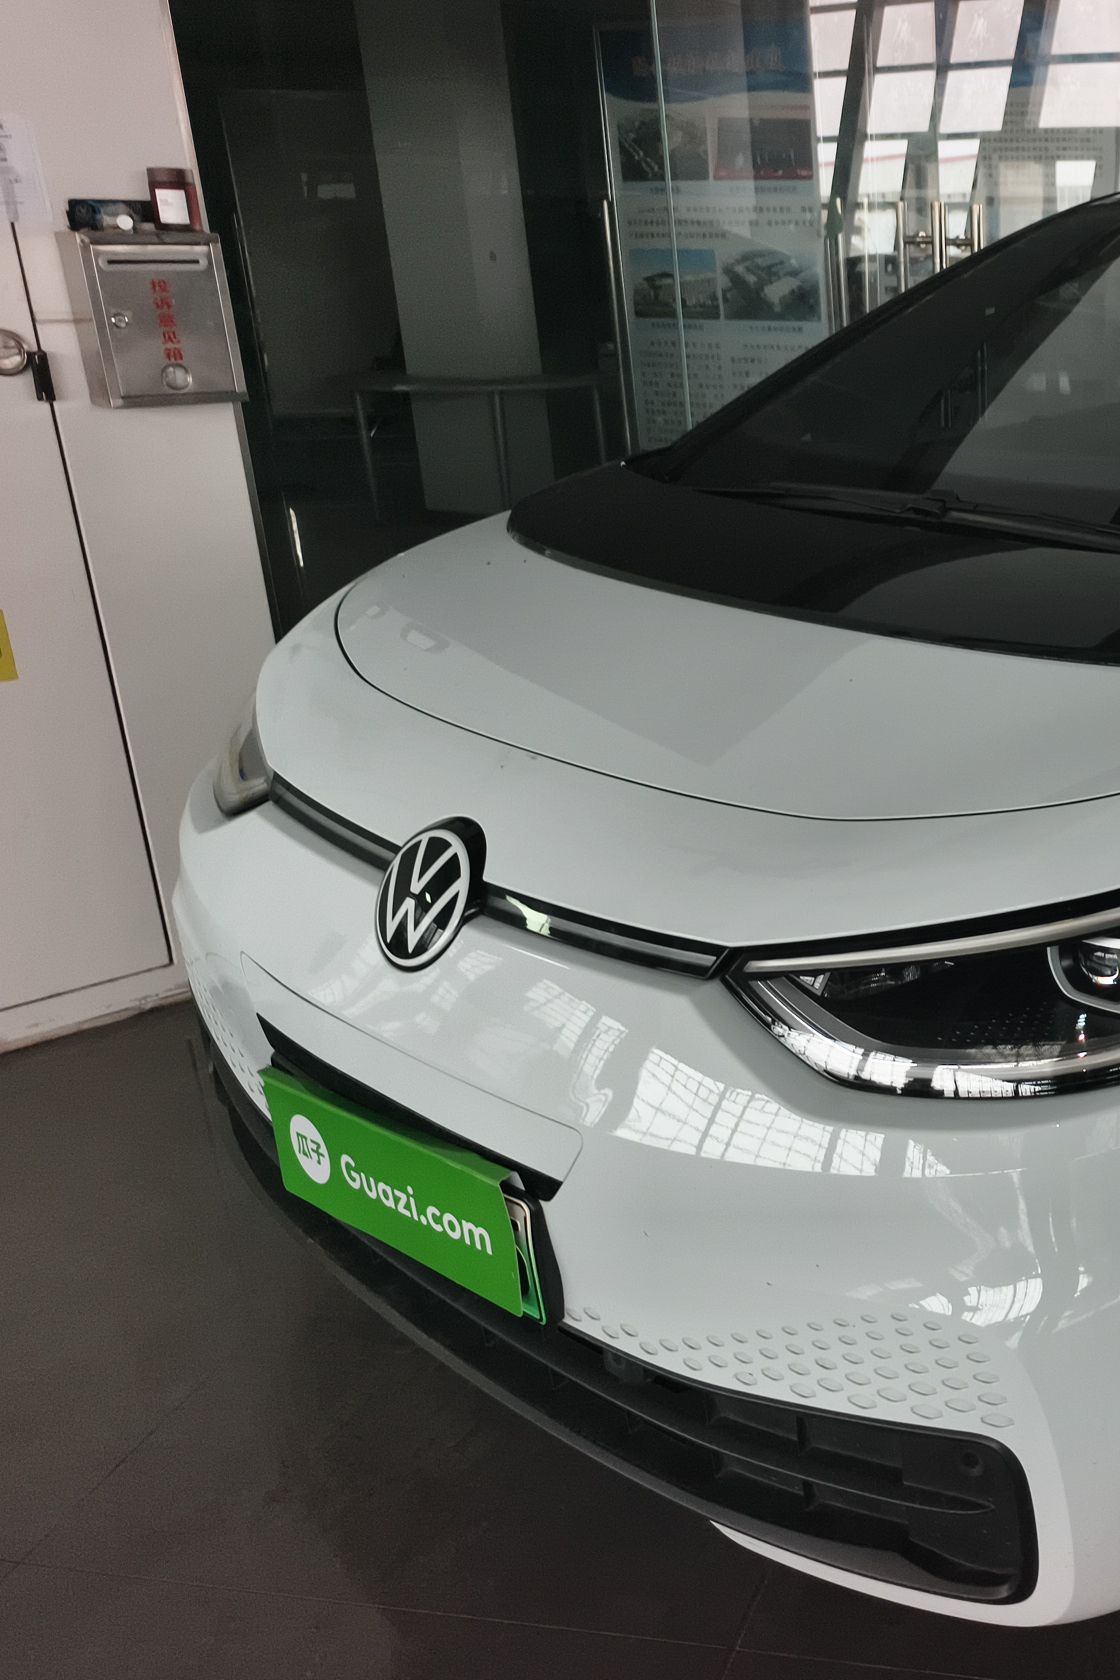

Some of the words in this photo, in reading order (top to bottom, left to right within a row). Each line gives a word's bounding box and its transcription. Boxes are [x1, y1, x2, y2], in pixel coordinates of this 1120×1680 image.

[150, 279, 184, 361] 投诉意见箱
[379, 831, 464, 962] VW
[295, 1131, 325, 1165] 瓜子
[340, 1153, 493, 1256] Guazi.com
